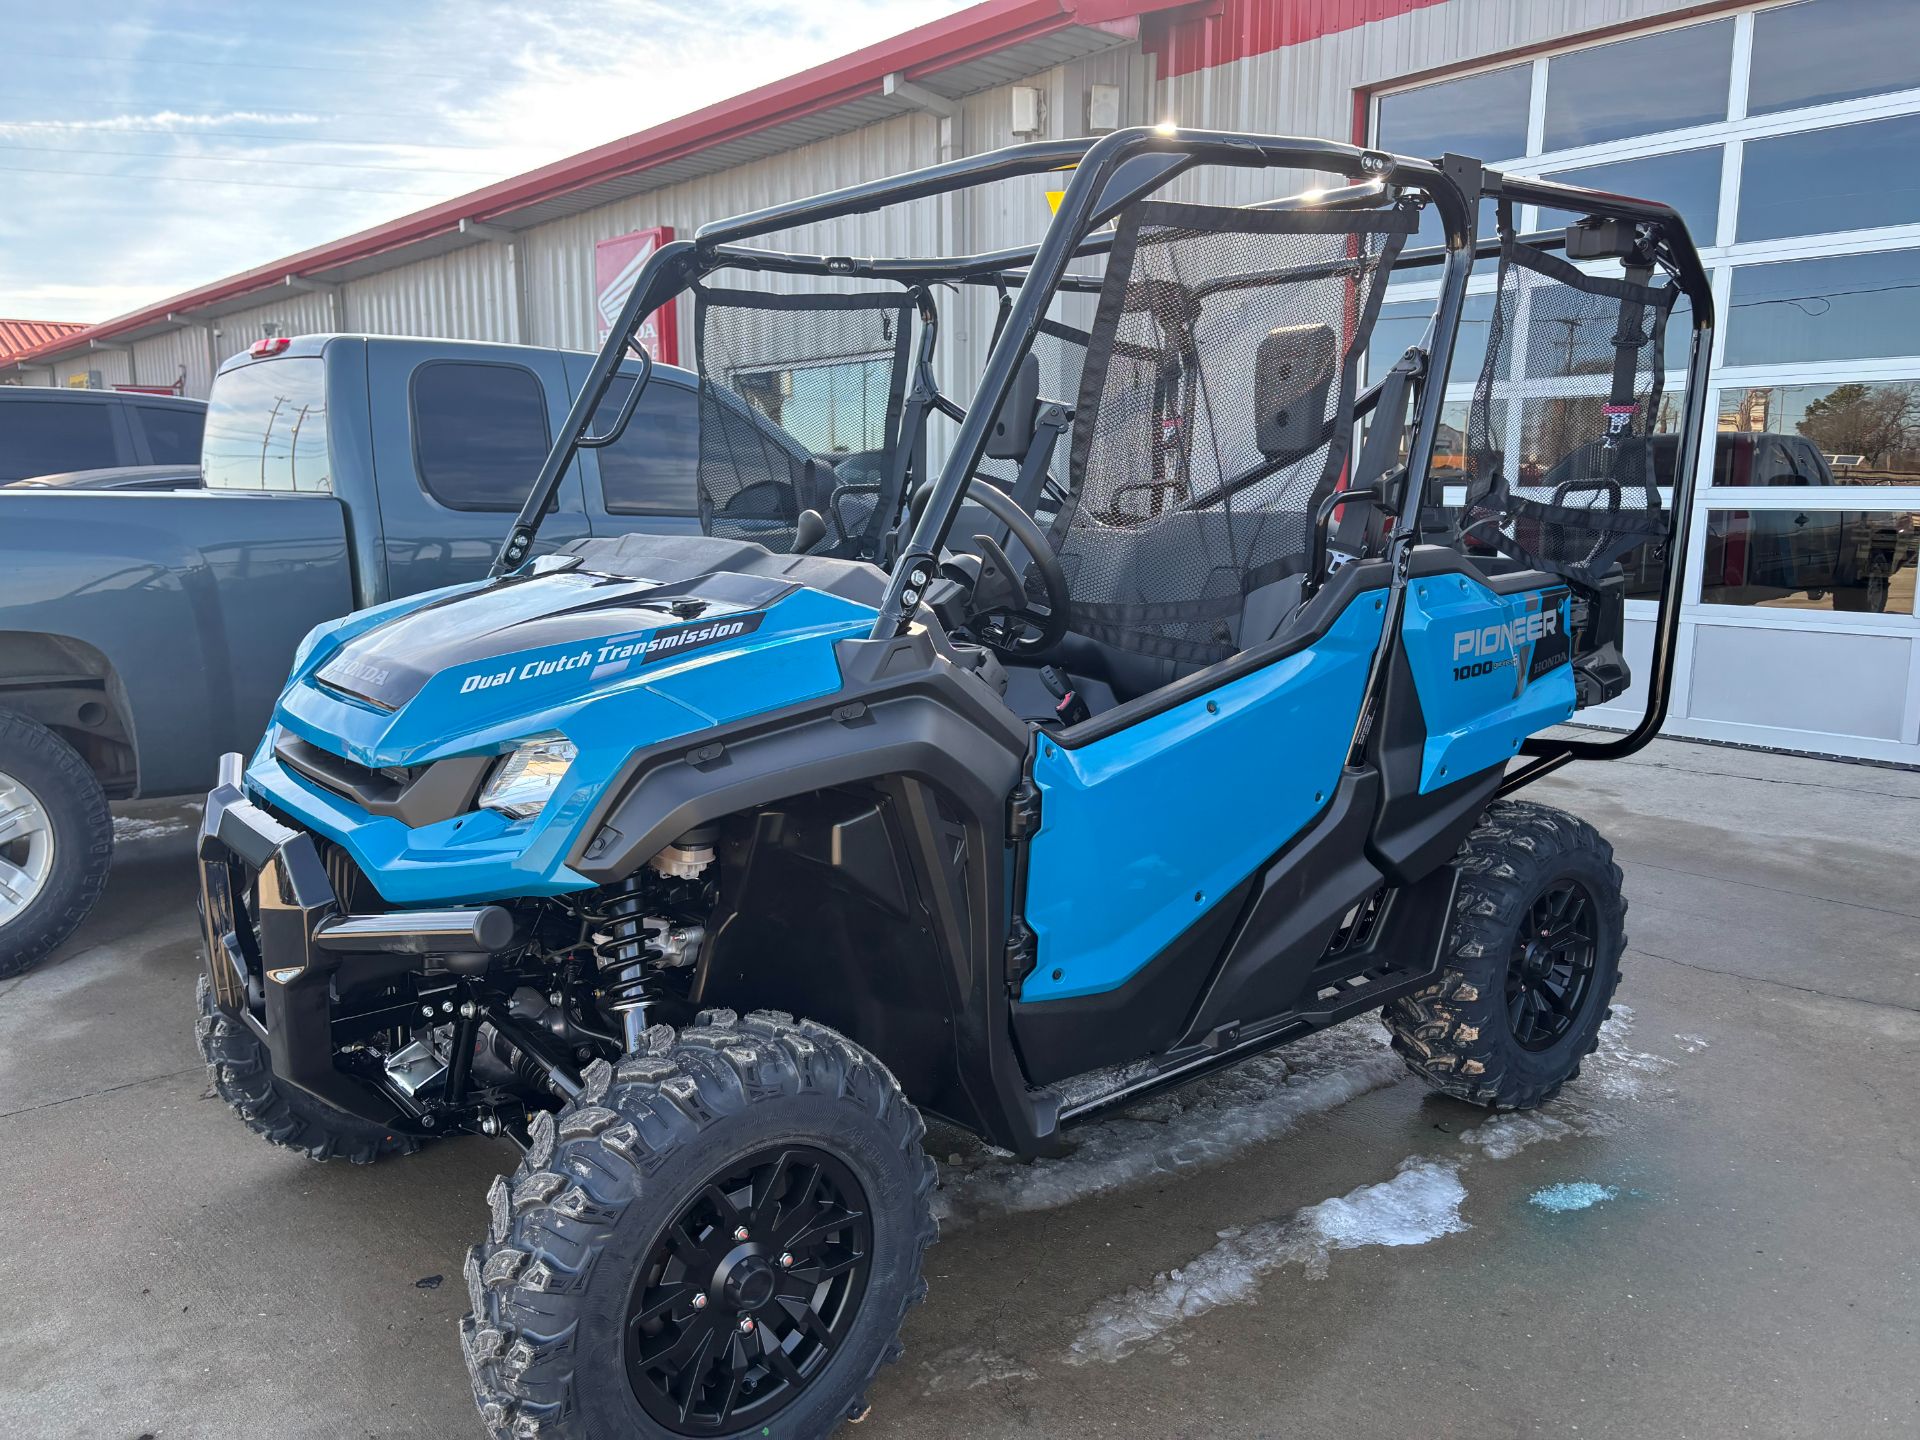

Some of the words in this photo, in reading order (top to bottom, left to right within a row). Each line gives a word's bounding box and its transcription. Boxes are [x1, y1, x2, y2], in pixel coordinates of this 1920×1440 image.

[599, 323, 657, 344] HDA
[1453, 609, 1557, 661] PIONEER
[460, 667, 516, 694] Dual
[519, 651, 593, 680] Clutch
[598, 621, 744, 663] Transmission
[1533, 651, 1568, 675] HONDA
[1453, 660, 1493, 682] 1000
